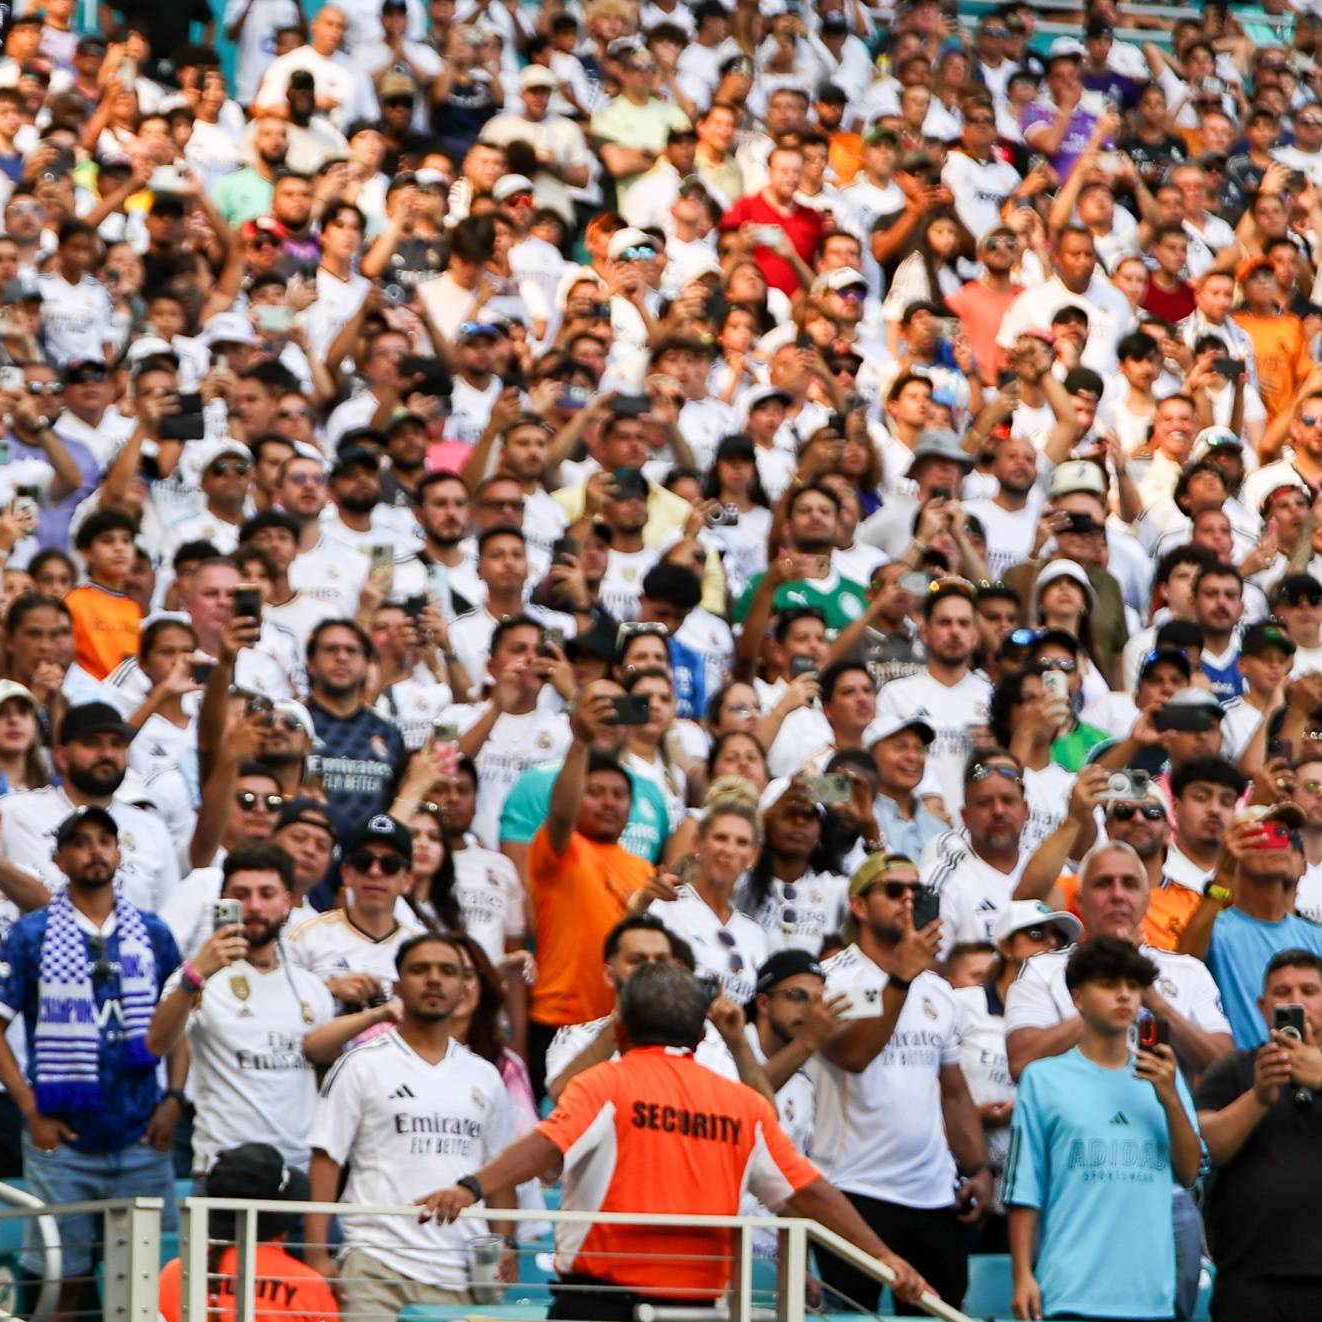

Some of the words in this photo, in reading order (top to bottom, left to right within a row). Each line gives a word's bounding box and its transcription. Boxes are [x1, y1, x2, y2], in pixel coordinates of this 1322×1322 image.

[395, 1111, 481, 1138] Emirates
[632, 1100, 742, 1147] SECURITY
[436, 1137, 471, 1156] BETTE
[1068, 1138, 1166, 1170] ADIDAS
